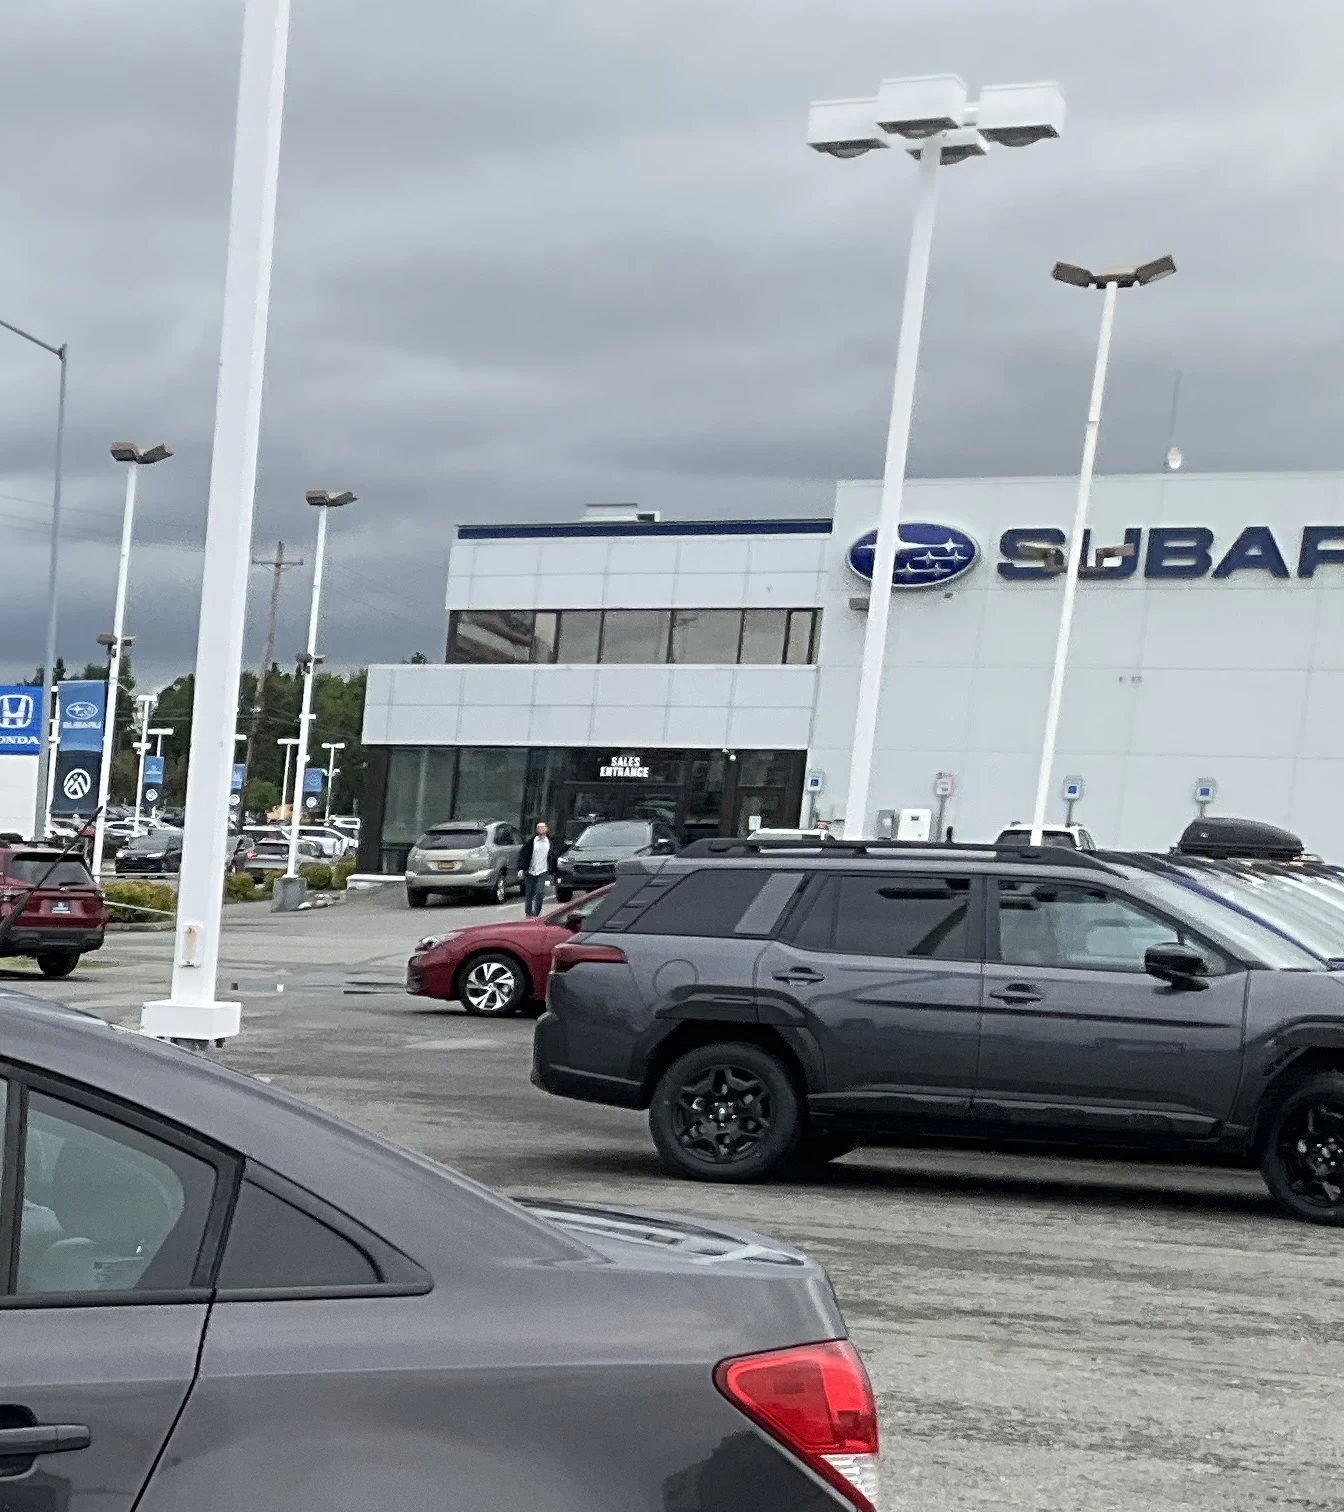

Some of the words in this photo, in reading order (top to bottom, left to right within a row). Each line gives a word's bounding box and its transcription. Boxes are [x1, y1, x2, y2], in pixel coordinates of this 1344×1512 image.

[62, 721, 102, 729] SUBARU
[611, 756, 641, 767] SALES
[600, 766, 650, 778] ENTRANCE
